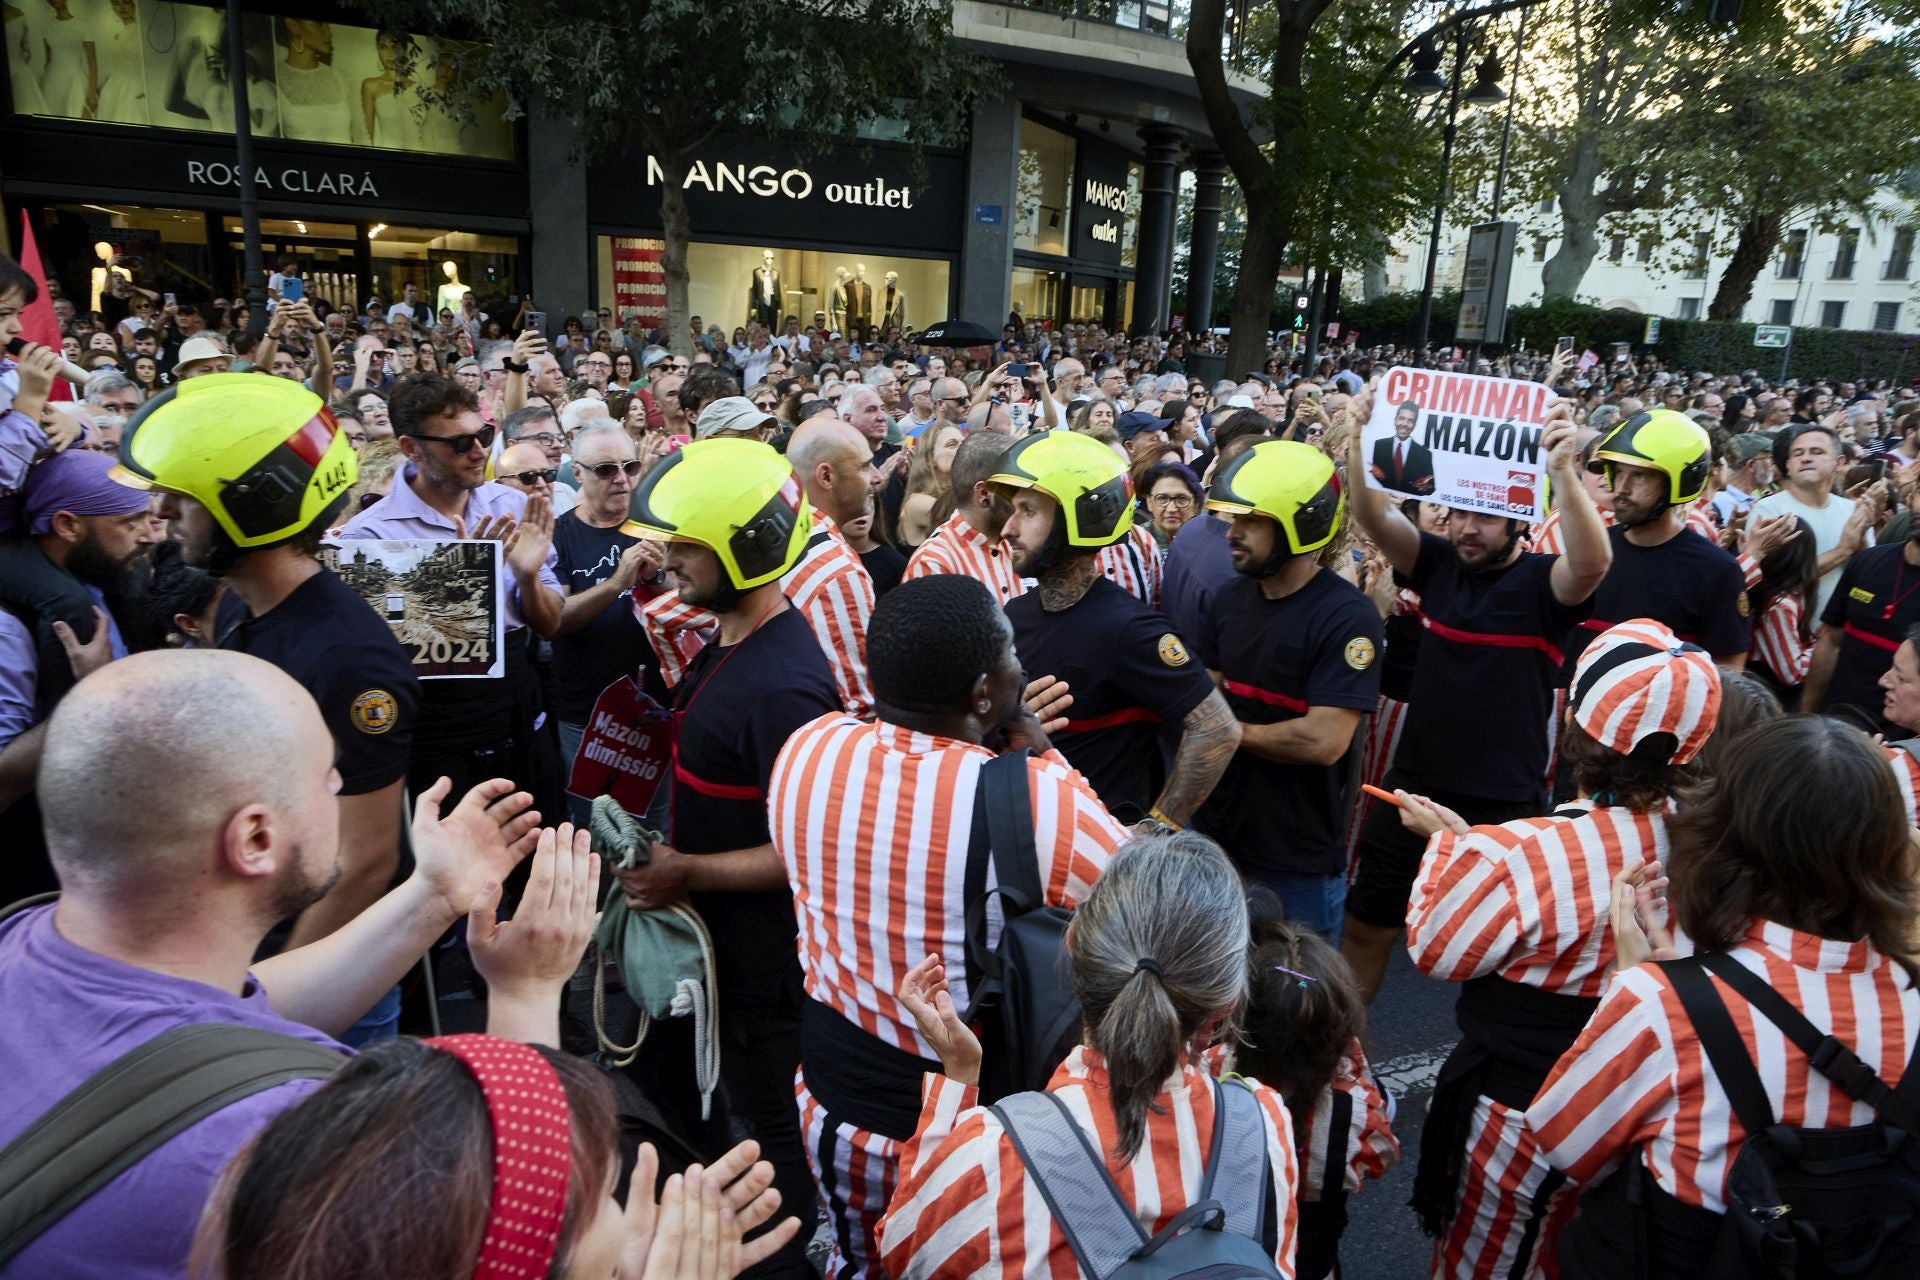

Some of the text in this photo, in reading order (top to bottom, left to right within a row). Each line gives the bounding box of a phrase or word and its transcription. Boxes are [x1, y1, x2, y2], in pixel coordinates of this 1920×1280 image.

[281, 169, 379, 197] CLARÁ
[825, 177, 914, 209] outlet
[1085, 178, 1128, 213] MANGO
[1092, 218, 1118, 244] outlet
[1386, 369, 1548, 425] CRIMINAL
[1424, 413, 1543, 465] MAZÓN
[1508, 502, 1535, 515] CGT
[412, 638, 490, 665] 2024
[592, 710, 652, 751] Mazón
[584, 738, 661, 780] dimissió
